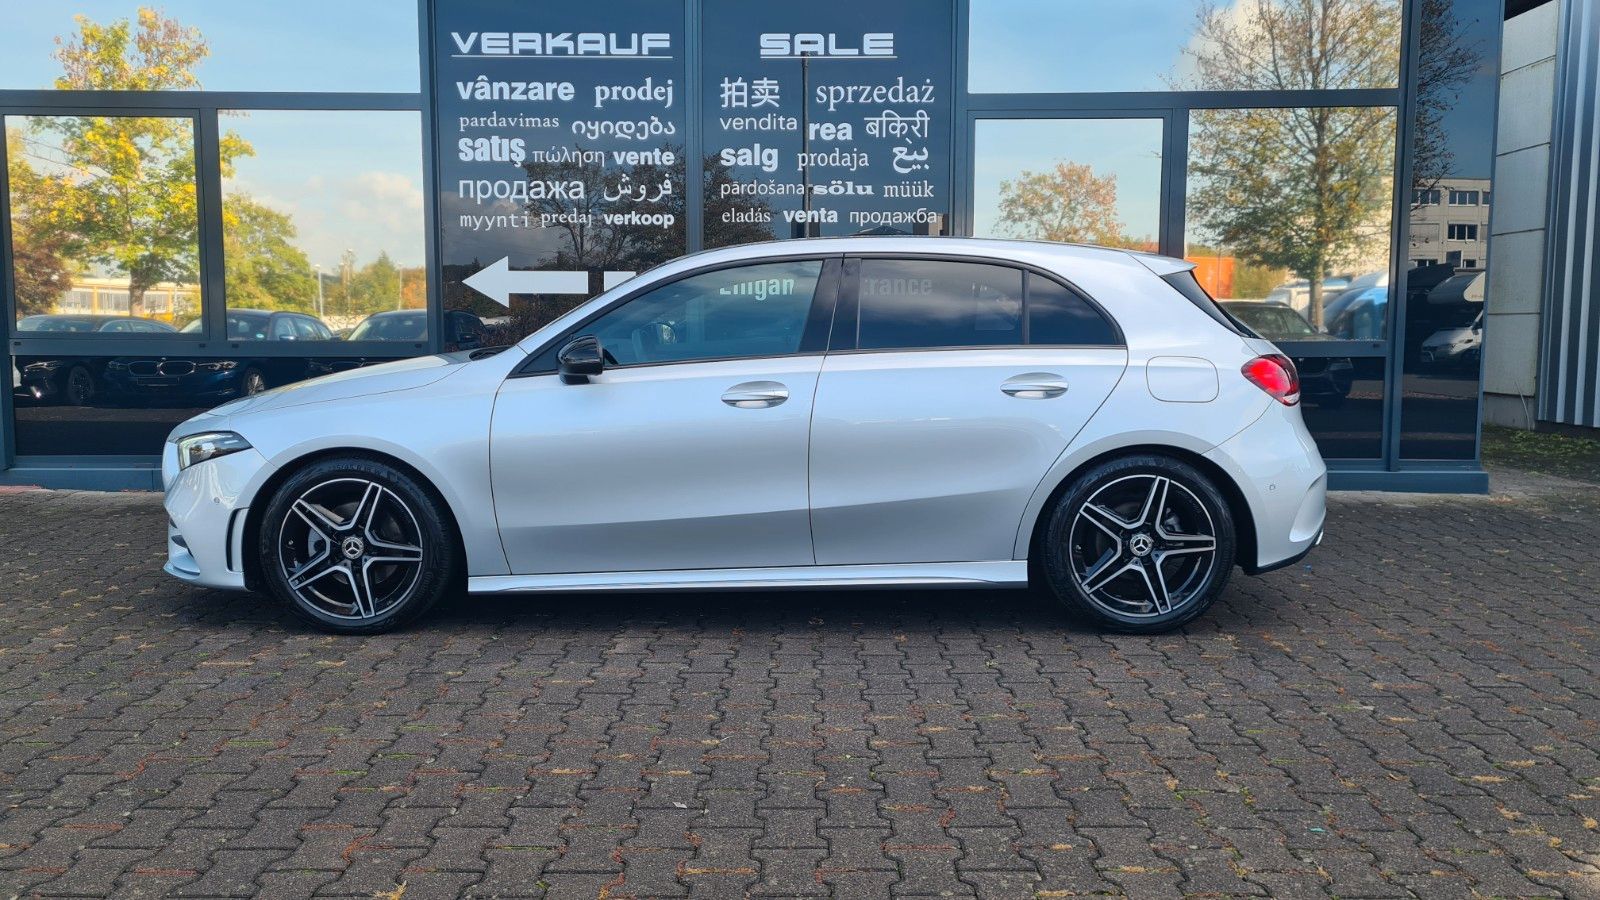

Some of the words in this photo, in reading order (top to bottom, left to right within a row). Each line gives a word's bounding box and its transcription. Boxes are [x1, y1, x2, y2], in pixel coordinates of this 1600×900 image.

[451, 32, 670, 55] VERKAUF
[760, 33, 893, 55] SALE
[457, 75, 574, 100] vânzare
[594, 77, 672, 108] prodej
[720, 77, 779, 107] 拍卖
[816, 77, 934, 111] sprzedaż
[460, 111, 559, 131] pardavimas
[720, 114, 797, 130] vendita
[809, 123, 852, 140] rea
[459, 136, 525, 167] satış
[532, 146, 604, 167] πώληση
[613, 148, 675, 165] vente
[721, 144, 778, 172] salg
[797, 148, 869, 171] prodaja
[459, 180, 584, 205] продажа
[721, 180, 804, 198] pārdošana
[814, 180, 874, 195] sölu
[884, 180, 934, 197] müük
[460, 211, 529, 231] myynti
[540, 208, 591, 228] predaj
[604, 211, 674, 228] verkoop
[722, 208, 770, 222] eladás
[783, 208, 838, 222] venta
[850, 208, 937, 226] продажба
